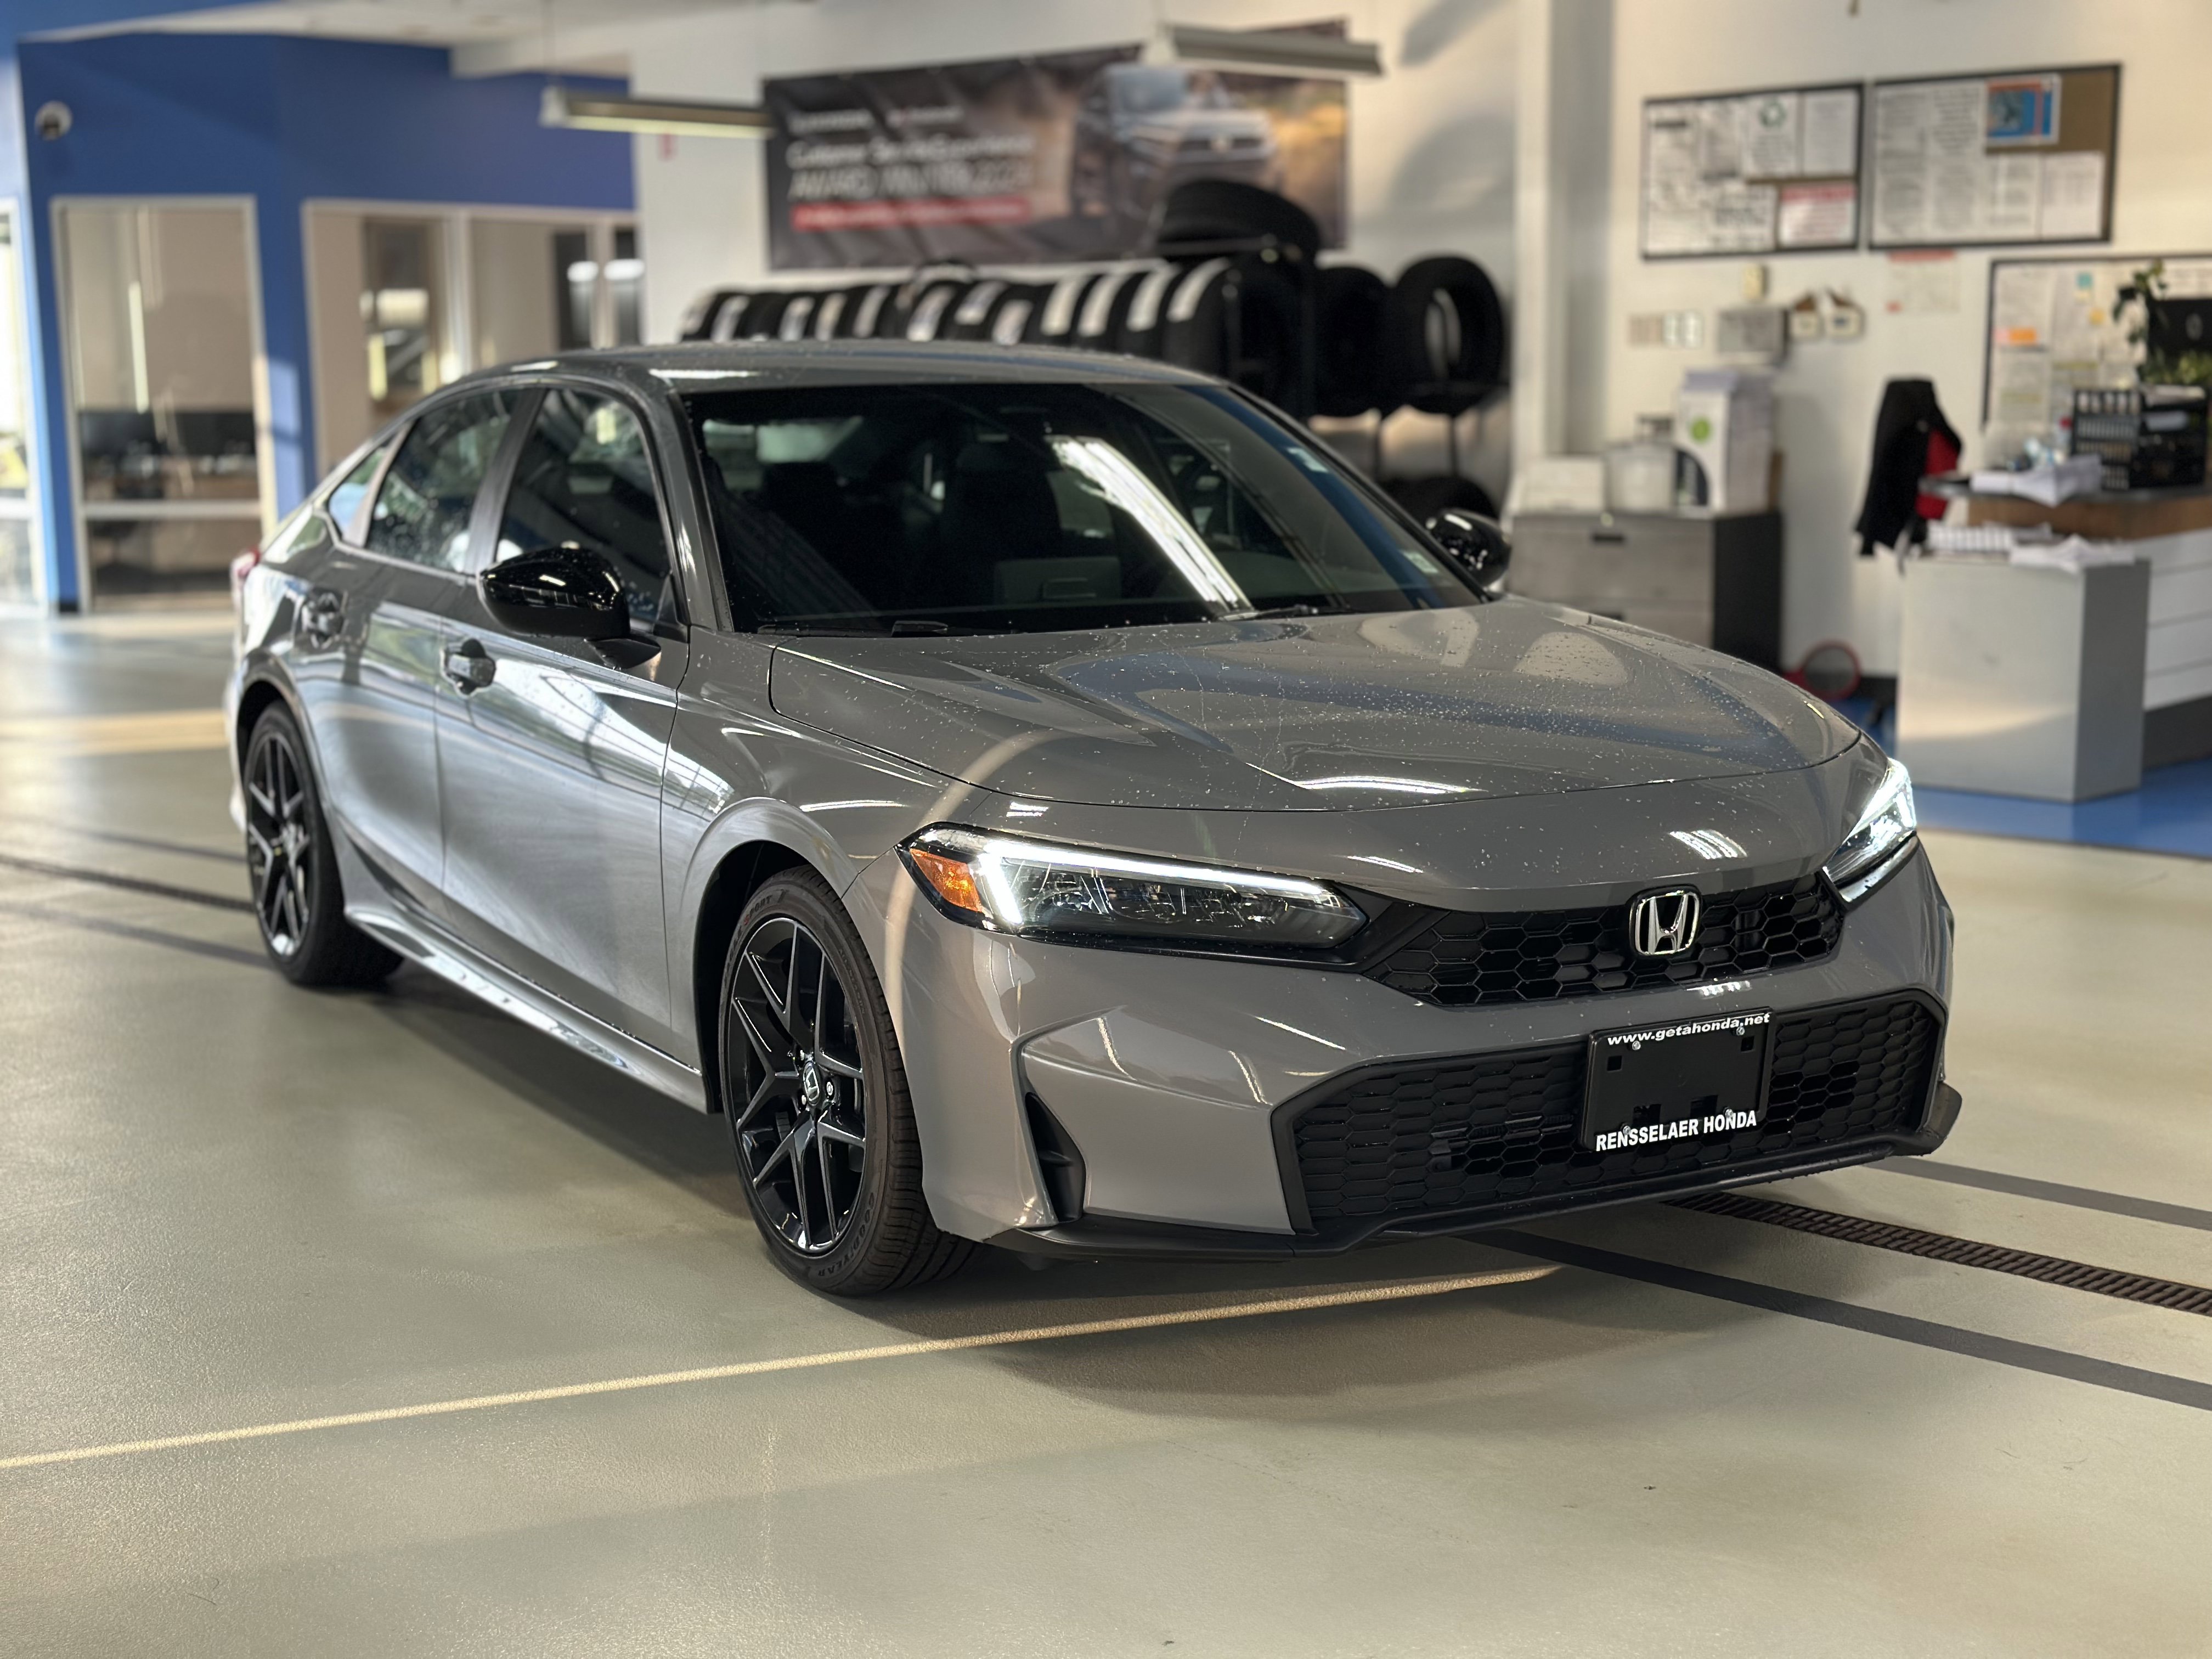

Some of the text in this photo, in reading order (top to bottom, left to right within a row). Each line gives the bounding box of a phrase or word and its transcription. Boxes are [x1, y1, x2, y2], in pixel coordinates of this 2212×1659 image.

[743, 895, 773, 926] SPORT
[1607, 1013, 1770, 1046] www.getahonda.net
[1596, 1110, 1757, 1152] RENSSELAER HONDA
[817, 1192, 874, 1277] GOODYEAR
